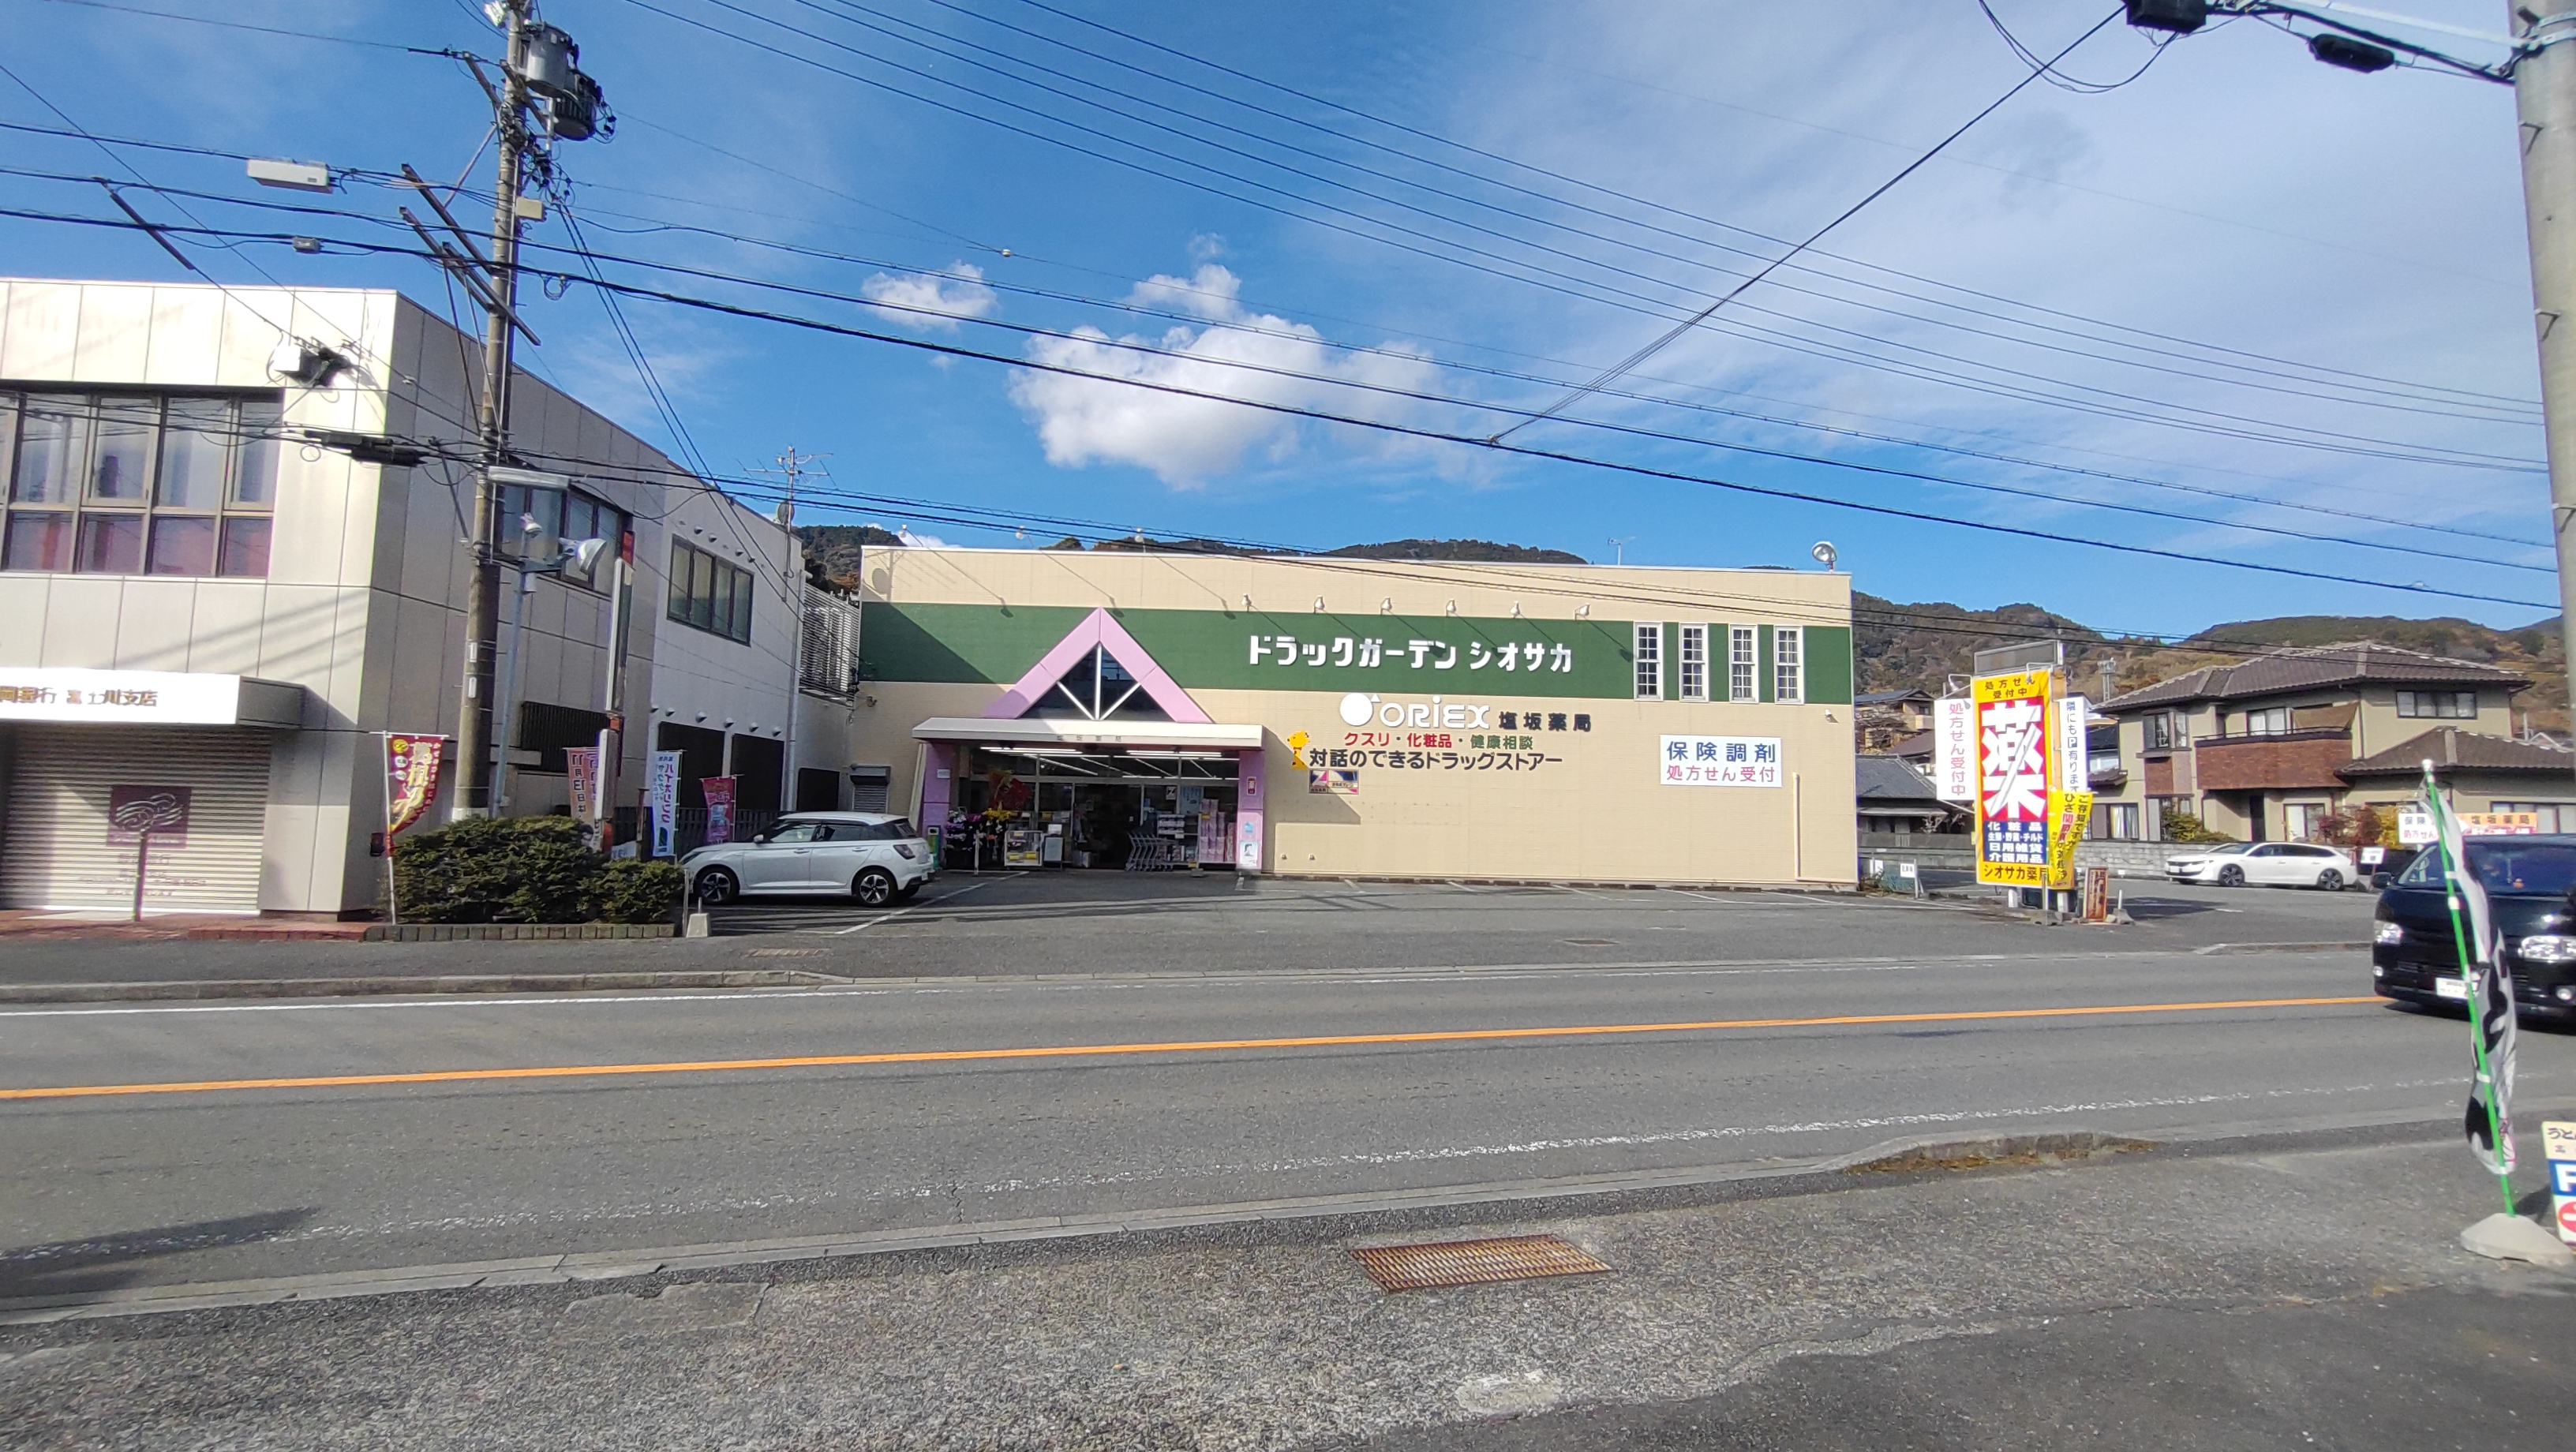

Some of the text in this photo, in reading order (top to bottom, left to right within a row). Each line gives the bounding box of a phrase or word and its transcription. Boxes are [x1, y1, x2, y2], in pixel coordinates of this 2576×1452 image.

[1249, 634, 1573, 673] ドラックガーデン シオサカ
[1993, 687, 2027, 700] 受付中
[1499, 711, 1593, 732] 塩坂薬局
[1309, 748, 1563, 771] 対話のできるドラッグストアー
[1666, 740, 1776, 763] 保険調剤
[1949, 702, 1966, 796] 処方せん受付中
[1981, 699, 2046, 819] 薬
[1666, 764, 1775, 783] 処方せん受付
[1987, 821, 2042, 832] 化粧品
[1989, 852, 2043, 864] 介護用品
[1990, 842, 2043, 854] 日用雑貨
